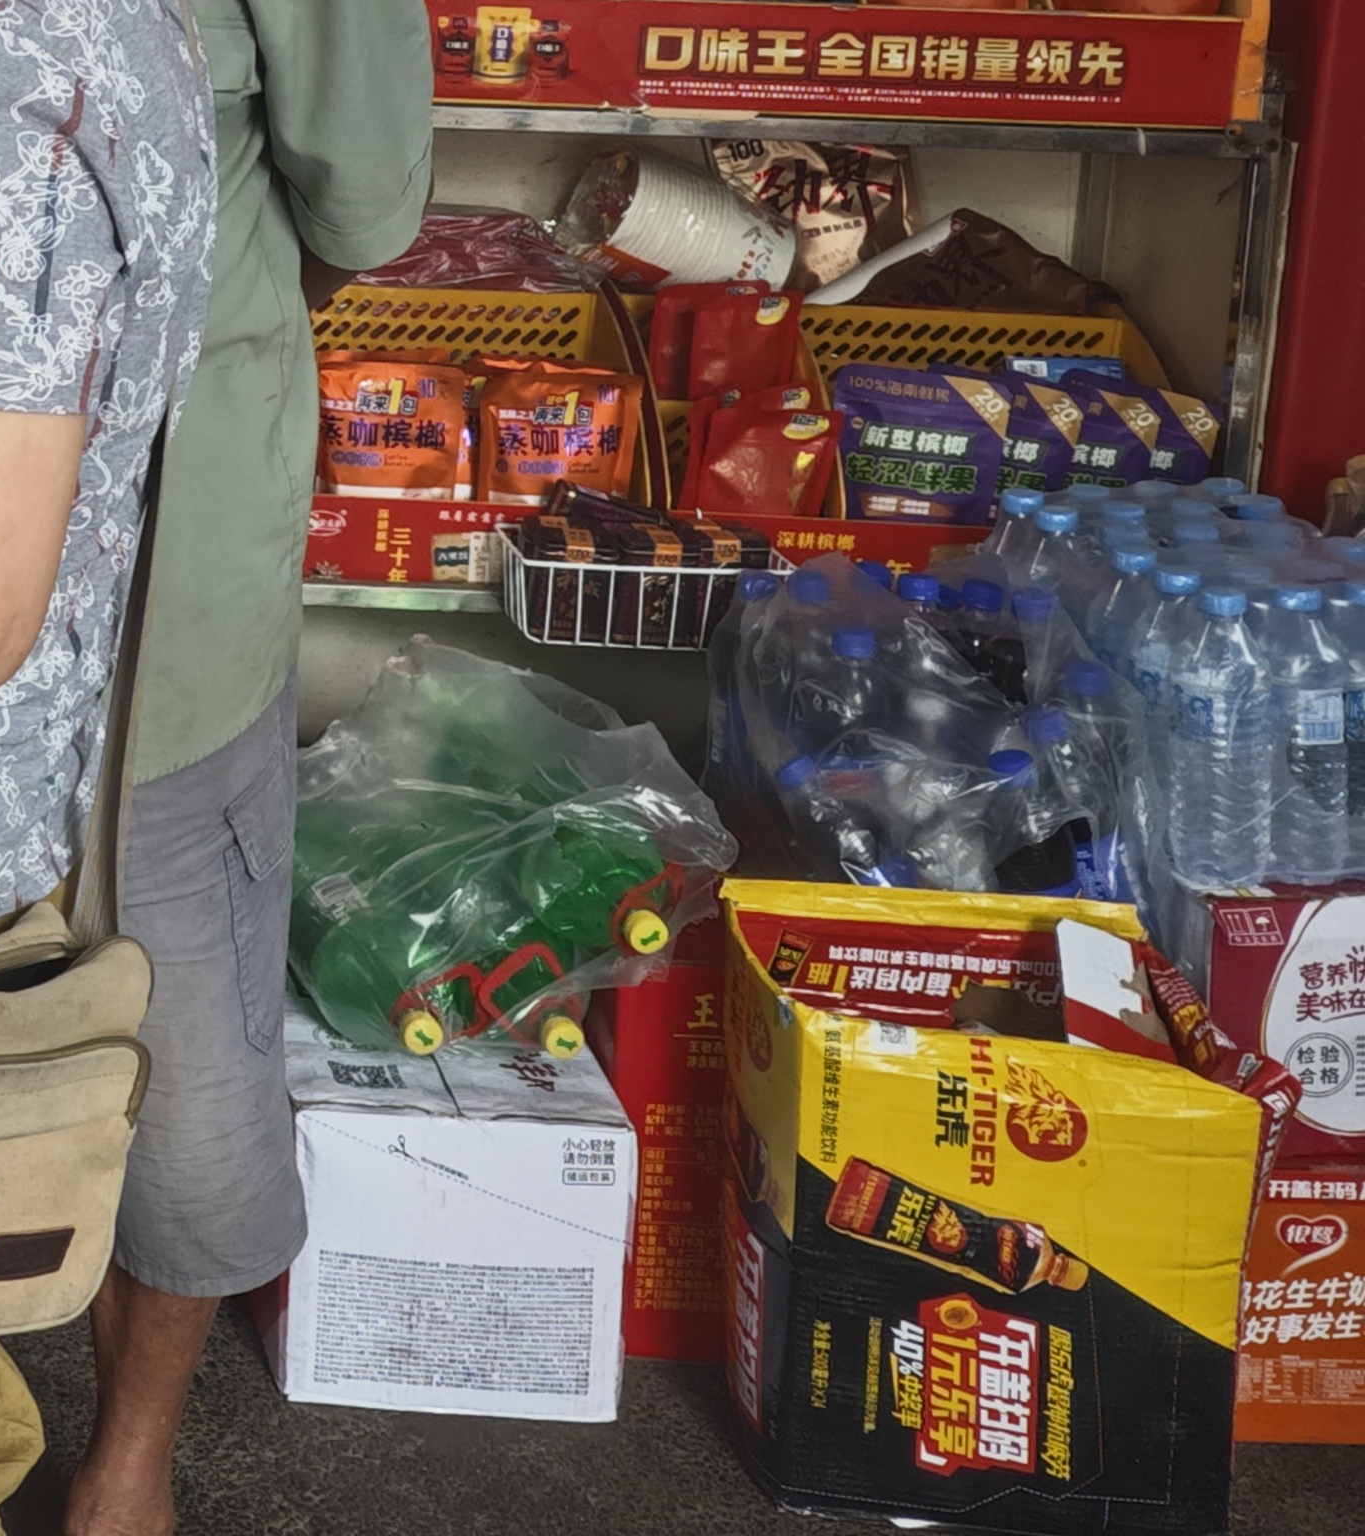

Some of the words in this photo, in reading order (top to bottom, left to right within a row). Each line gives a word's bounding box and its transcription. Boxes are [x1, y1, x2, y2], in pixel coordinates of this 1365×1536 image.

[727, 139, 765, 162] 100
[975, 389, 1004, 414] 20
[1052, 398, 1079, 424] 20
[1128, 404, 1155, 428] 20
[1186, 407, 1214, 432] 20
[322, 417, 447, 450] 蒸咖槟榔
[865, 425, 969, 457] 新型槟榔
[845, 454, 977, 495] 轻涩鲜果
[776, 530, 856, 552] 深耕槟榔
[1297, 1045, 1342, 1064] 检验
[1297, 1067, 1341, 1086] 合格
[933, 1070, 970, 1149] 乐虎
[969, 1038, 999, 1187] HI-TIGER
[562, 1138, 616, 1152] 小心轻放
[562, 1152, 616, 1166] 请勿倒置
[891, 1319, 926, 1430] 40%中奖率
